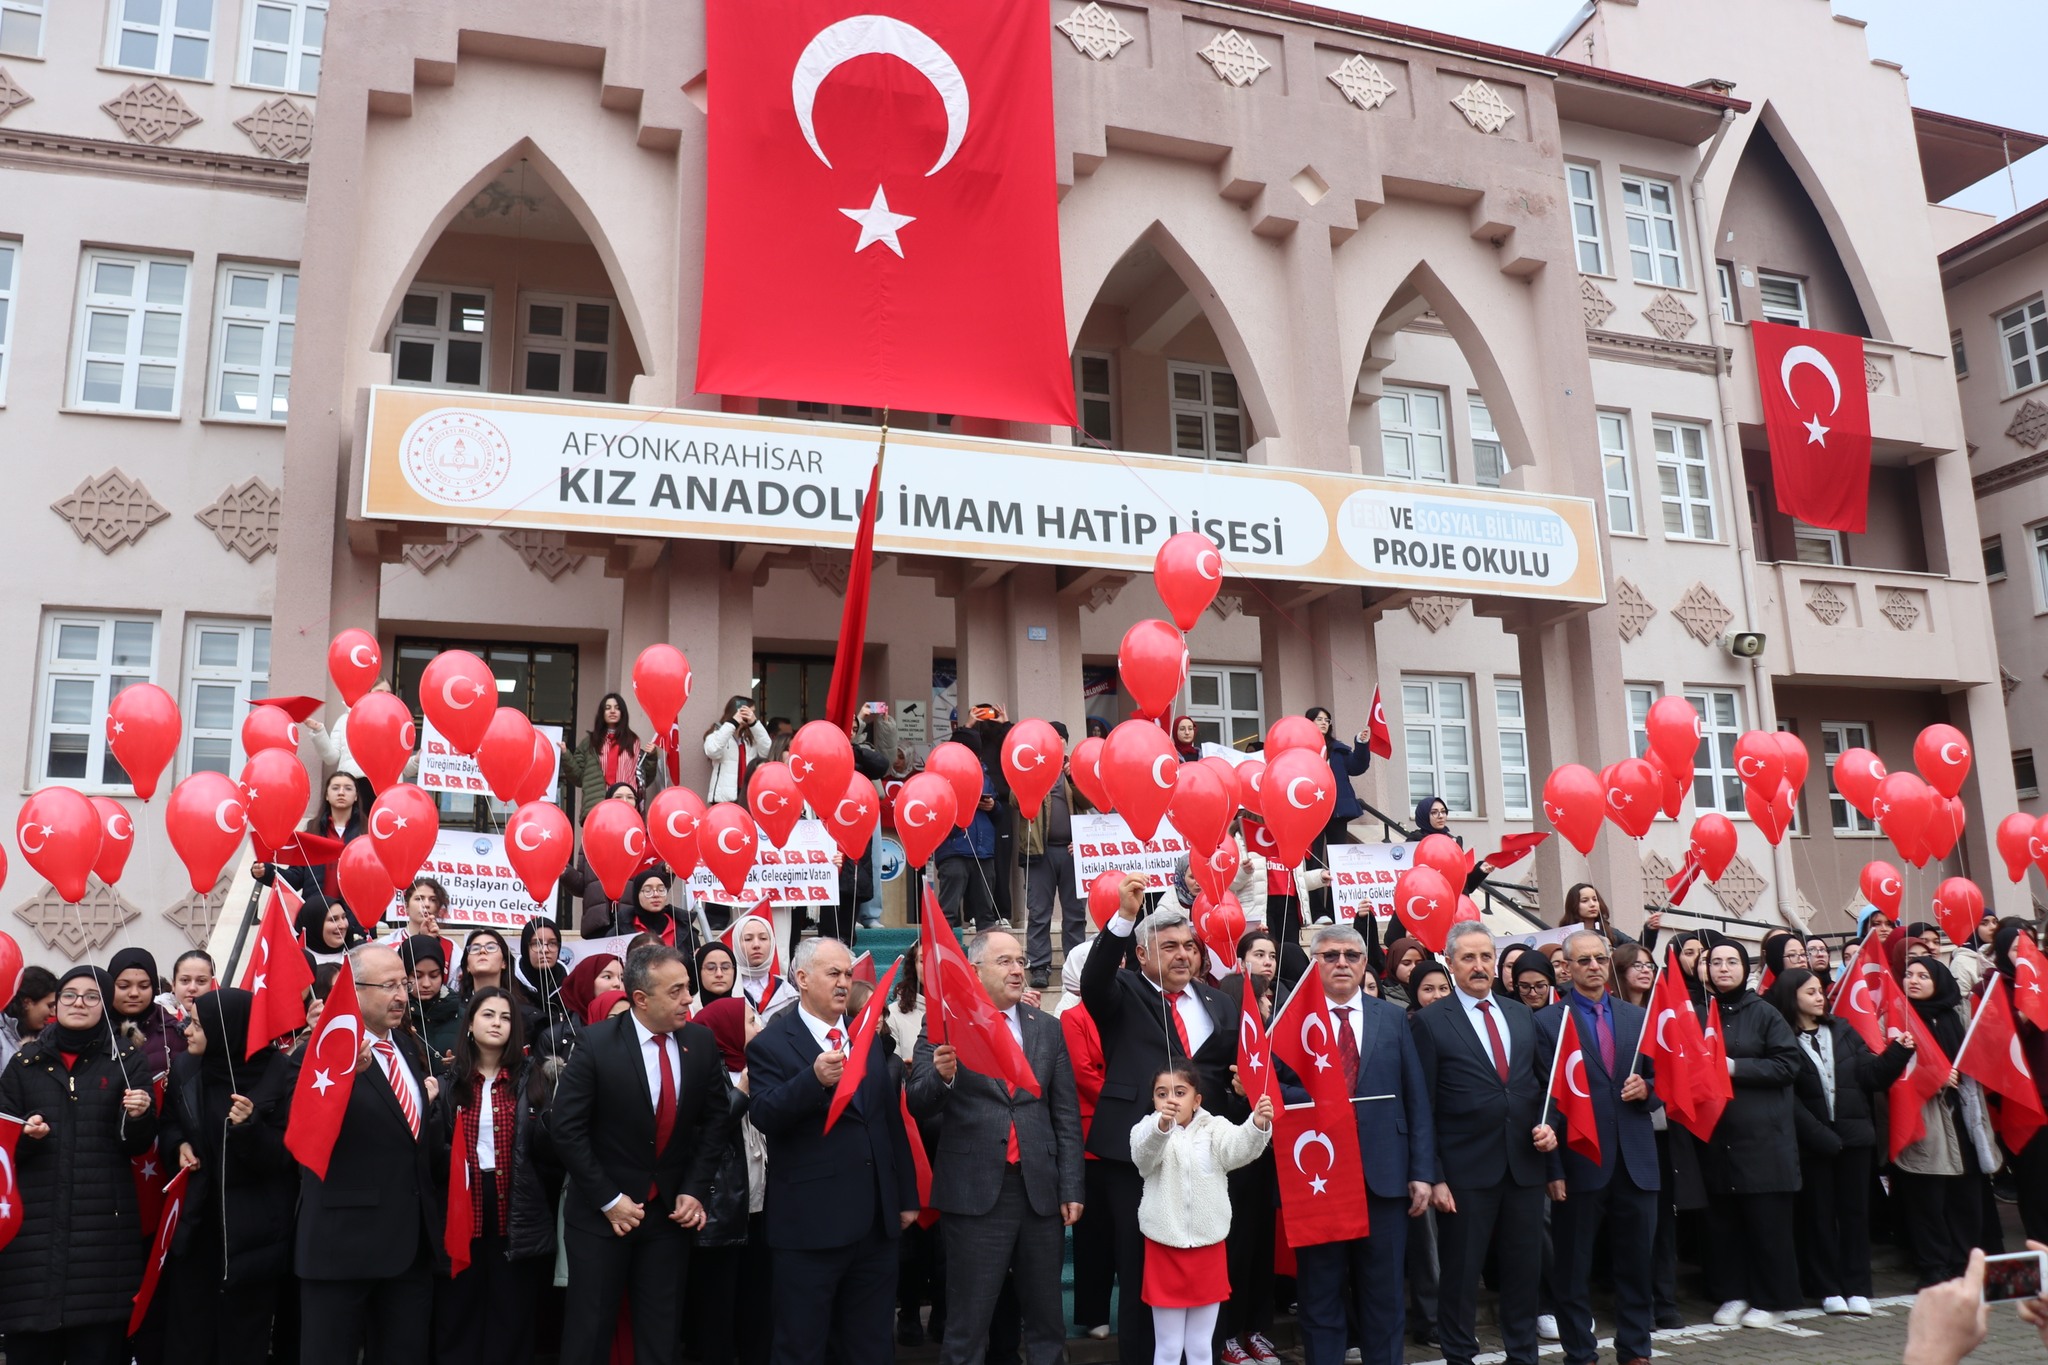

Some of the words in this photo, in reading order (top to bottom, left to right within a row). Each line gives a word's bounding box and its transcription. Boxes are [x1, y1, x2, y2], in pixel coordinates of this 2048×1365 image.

[562, 431, 823, 474] AFYONKARAHİSAR
[560, 467, 636, 507] KIZ
[899, 484, 1023, 535] İMAM
[1037, 504, 1157, 545] HATİP
[1354, 502, 1387, 529] FEN
[1390, 506, 1413, 530] VE
[1417, 509, 1483, 537] SOSYAL
[1485, 511, 1562, 545] BİLİMLER
[1373, 537, 1456, 570] PROJE
[1462, 545, 1549, 578] OKULU
[426, 757, 461, 772] Yüreğimiz
[1081, 862, 1108, 874] İstiklal
[1144, 857, 1172, 869] İstikbal
[761, 868, 808, 884] Geleceğimiz
[809, 868, 831, 880] Vatan
[454, 877, 509, 893] Başlayan
[450, 894, 496, 909] üyüyen
[1338, 889, 1348, 903] Ay
[1347, 889, 1367, 900] Yıldız
